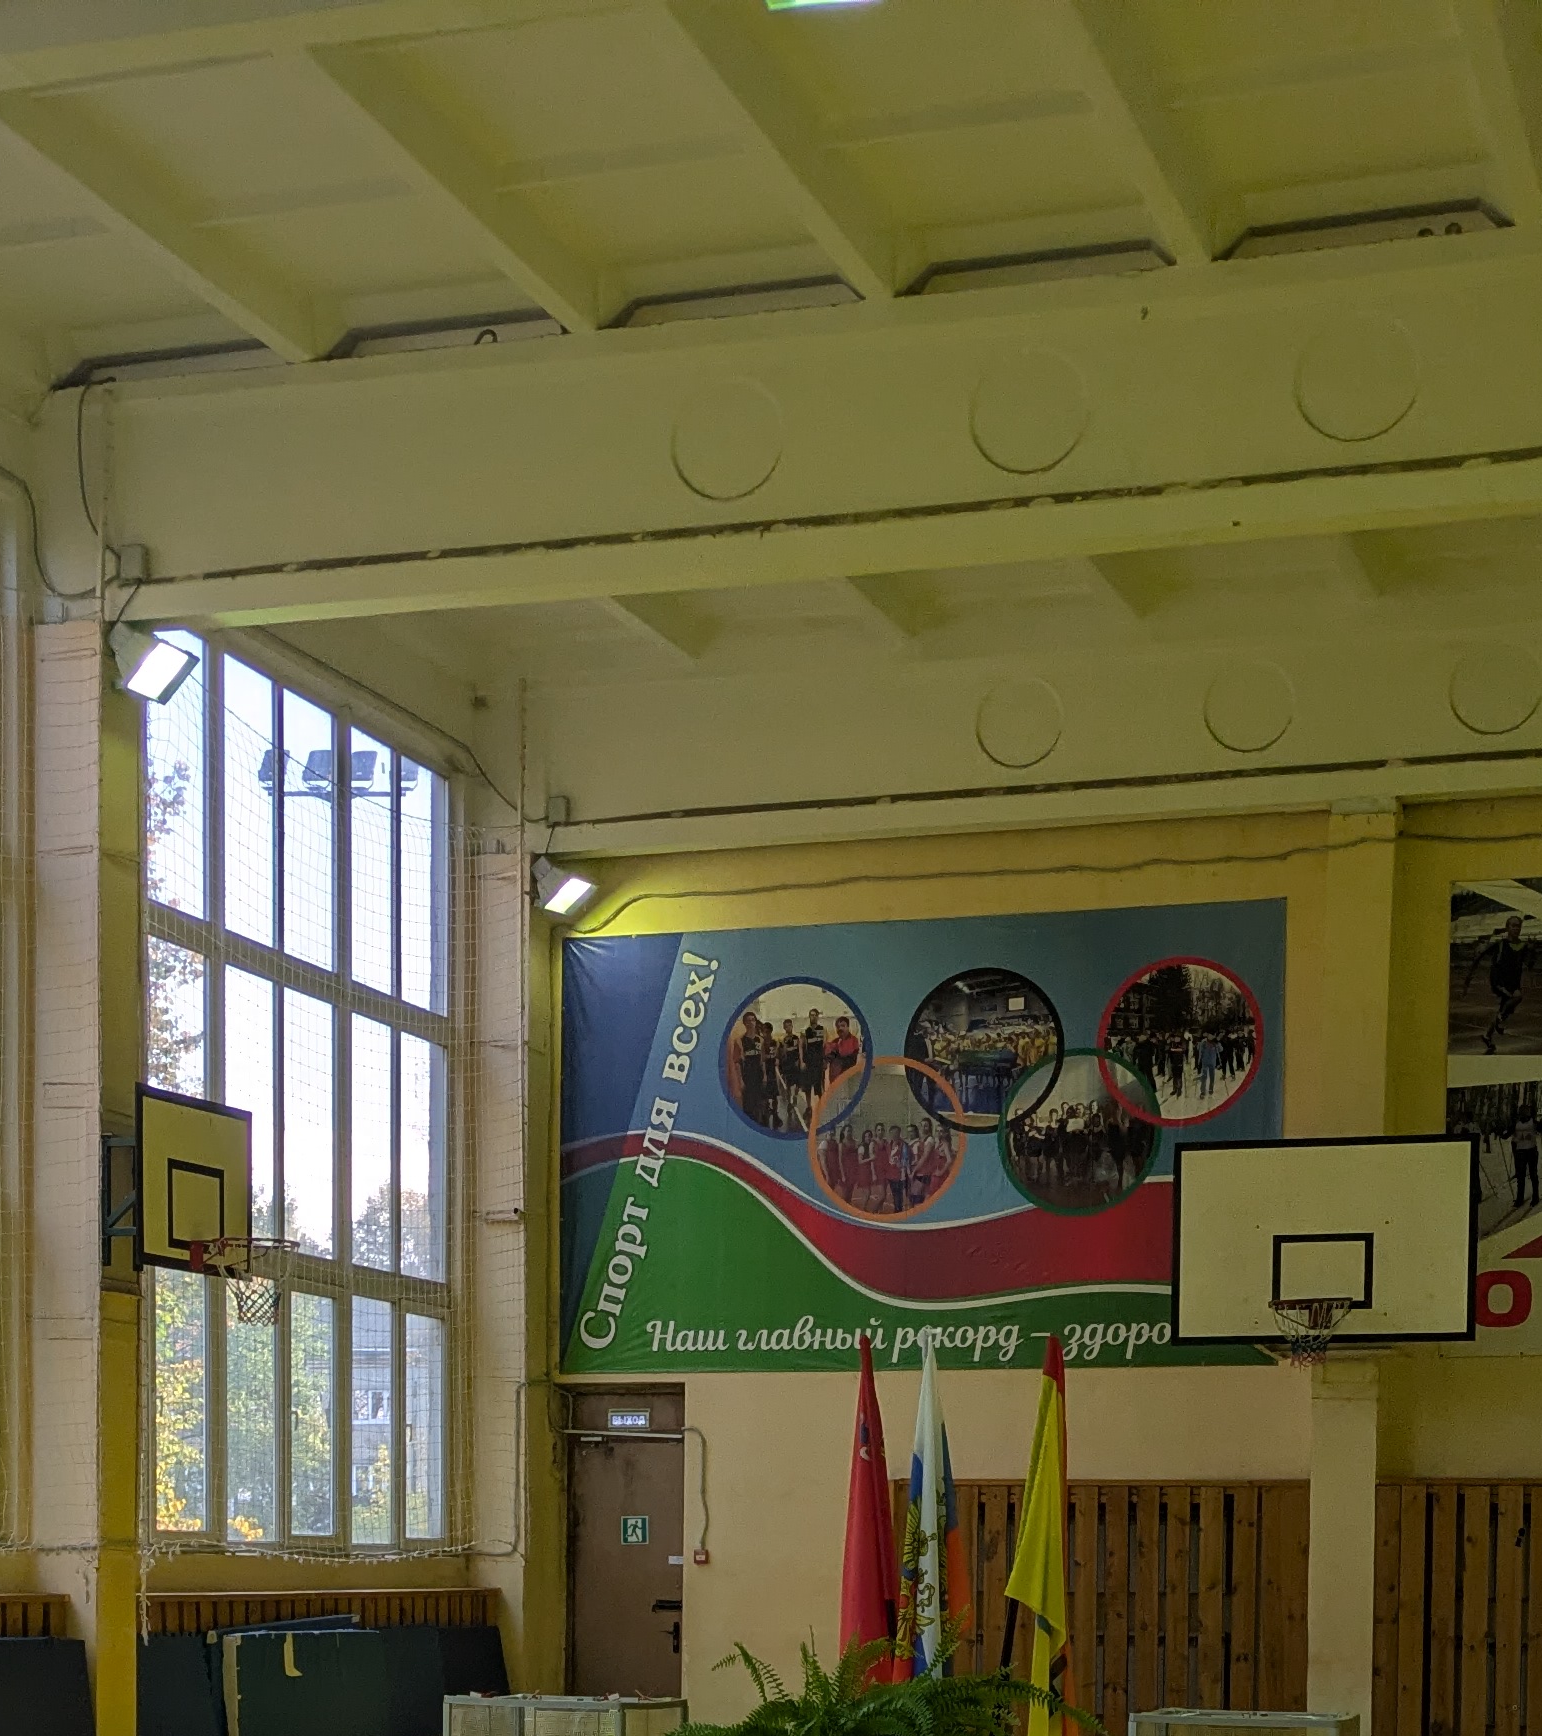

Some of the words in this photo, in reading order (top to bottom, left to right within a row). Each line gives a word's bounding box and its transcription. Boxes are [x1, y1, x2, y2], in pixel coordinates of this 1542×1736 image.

[580, 1197, 649, 1350] Спорт
[635, 1097, 679, 1187] для
[663, 951, 720, 1084] всех!
[646, 1320, 729, 1352] Наш
[736, 1315, 888, 1351] главный
[612, 1415, 646, 1426] ВЫХОД
